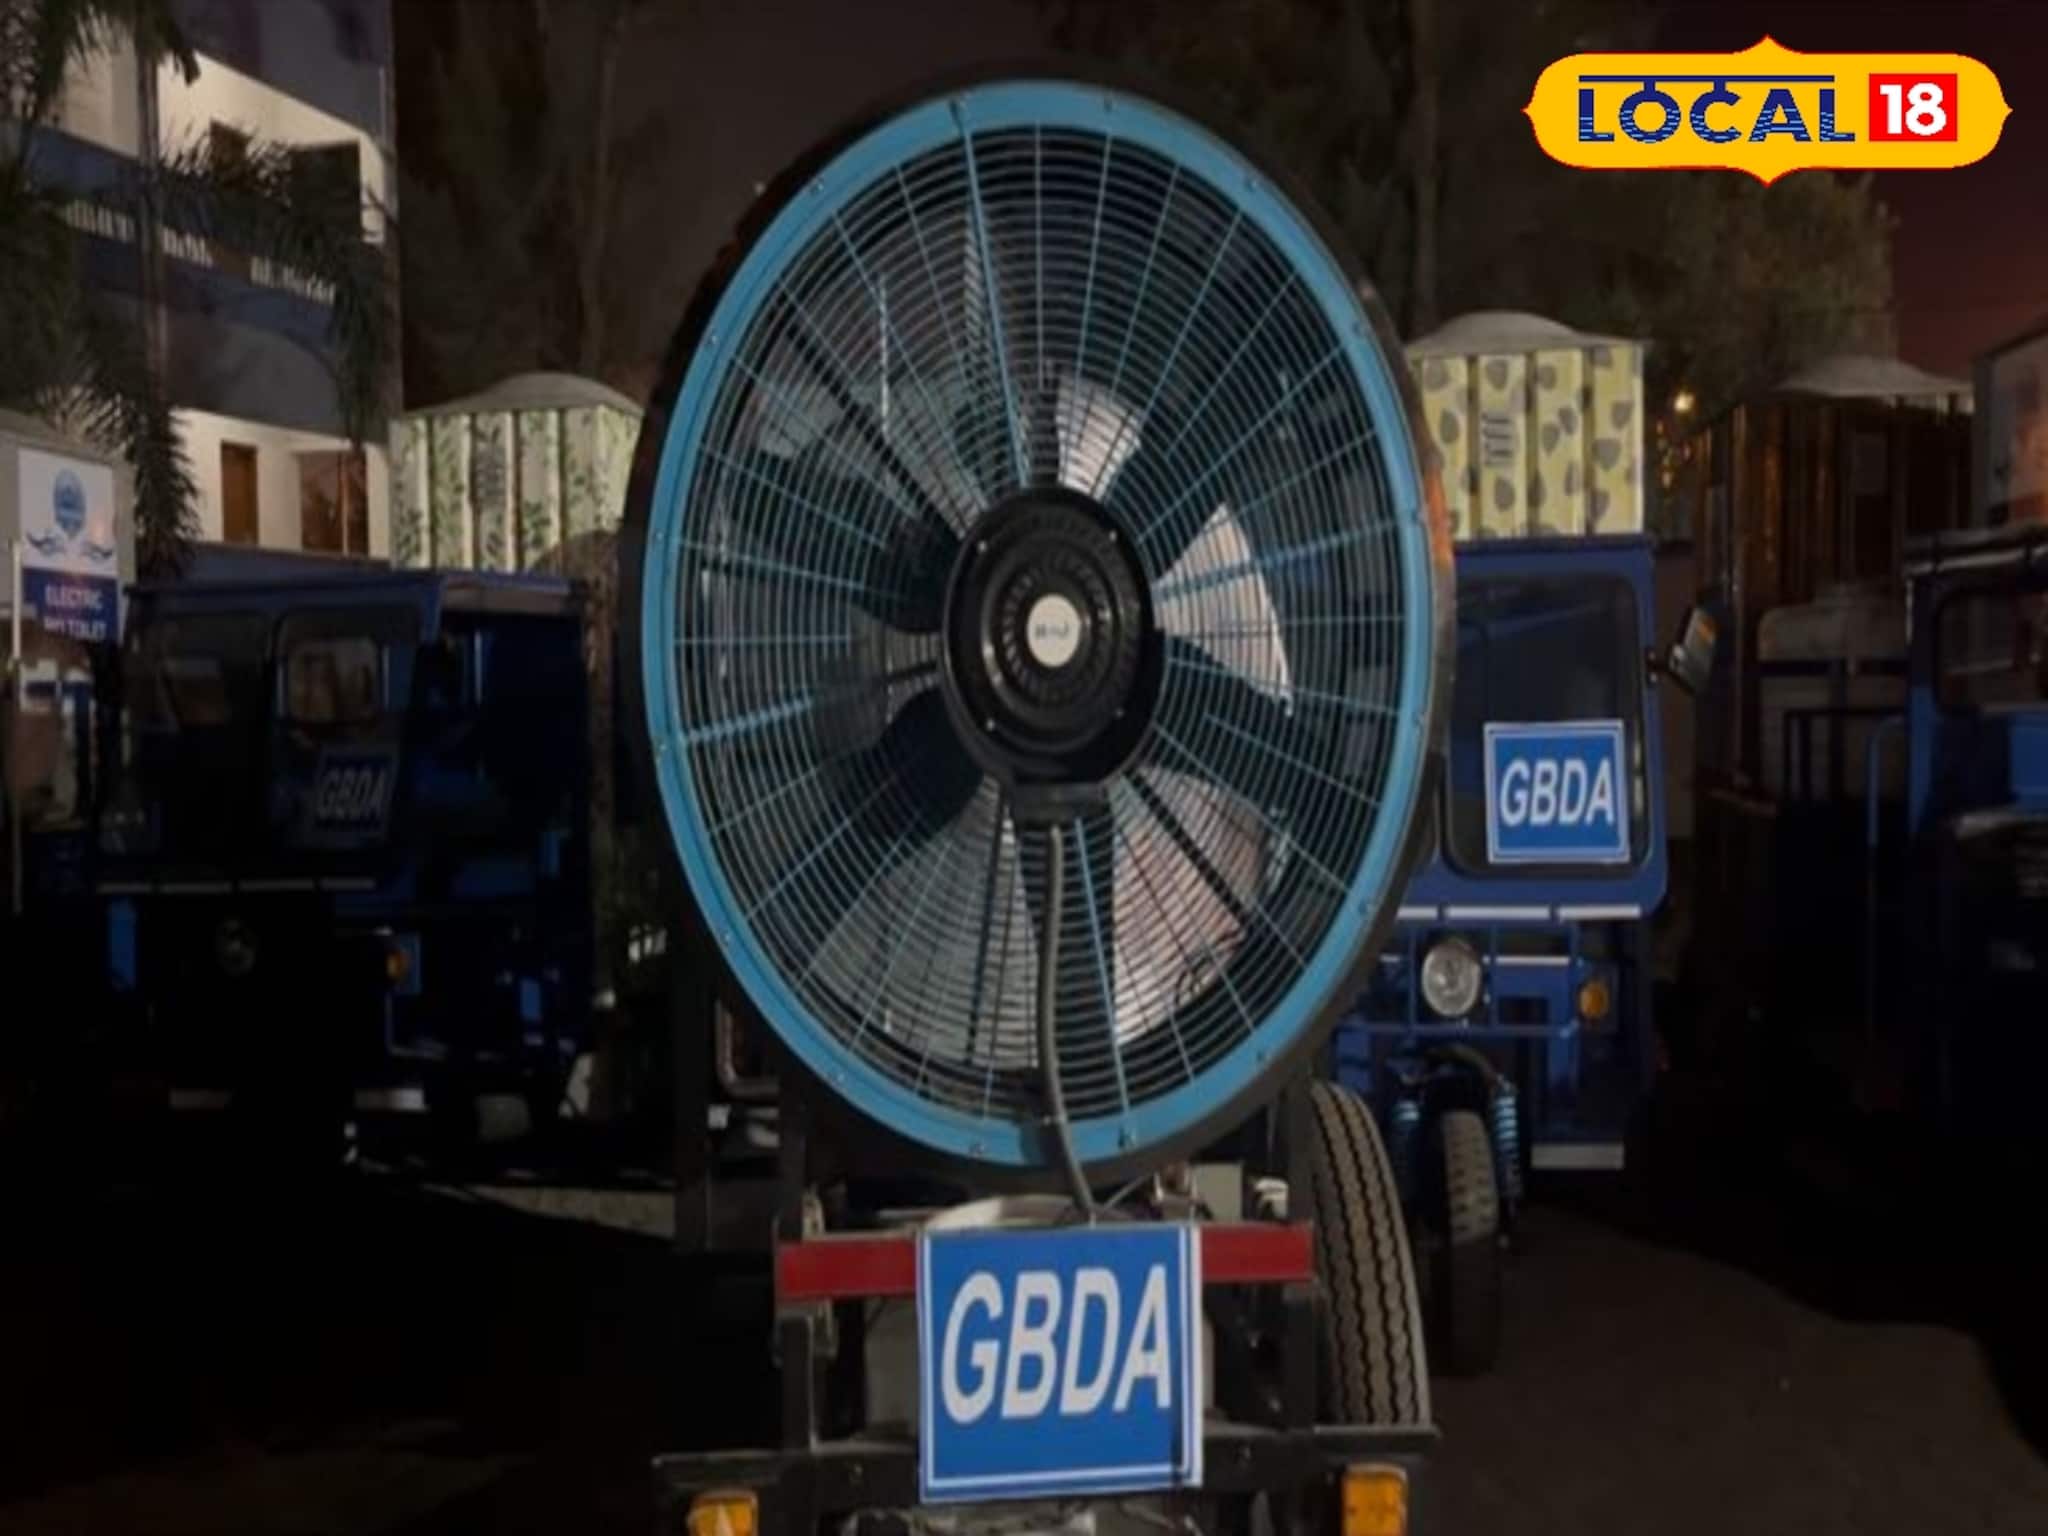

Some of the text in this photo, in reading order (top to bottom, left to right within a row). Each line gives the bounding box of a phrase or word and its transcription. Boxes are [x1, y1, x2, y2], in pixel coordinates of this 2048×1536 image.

[315, 763, 384, 819] GBDA
[1500, 756, 1615, 826] GBDA
[941, 1264, 1172, 1425] GBDA
